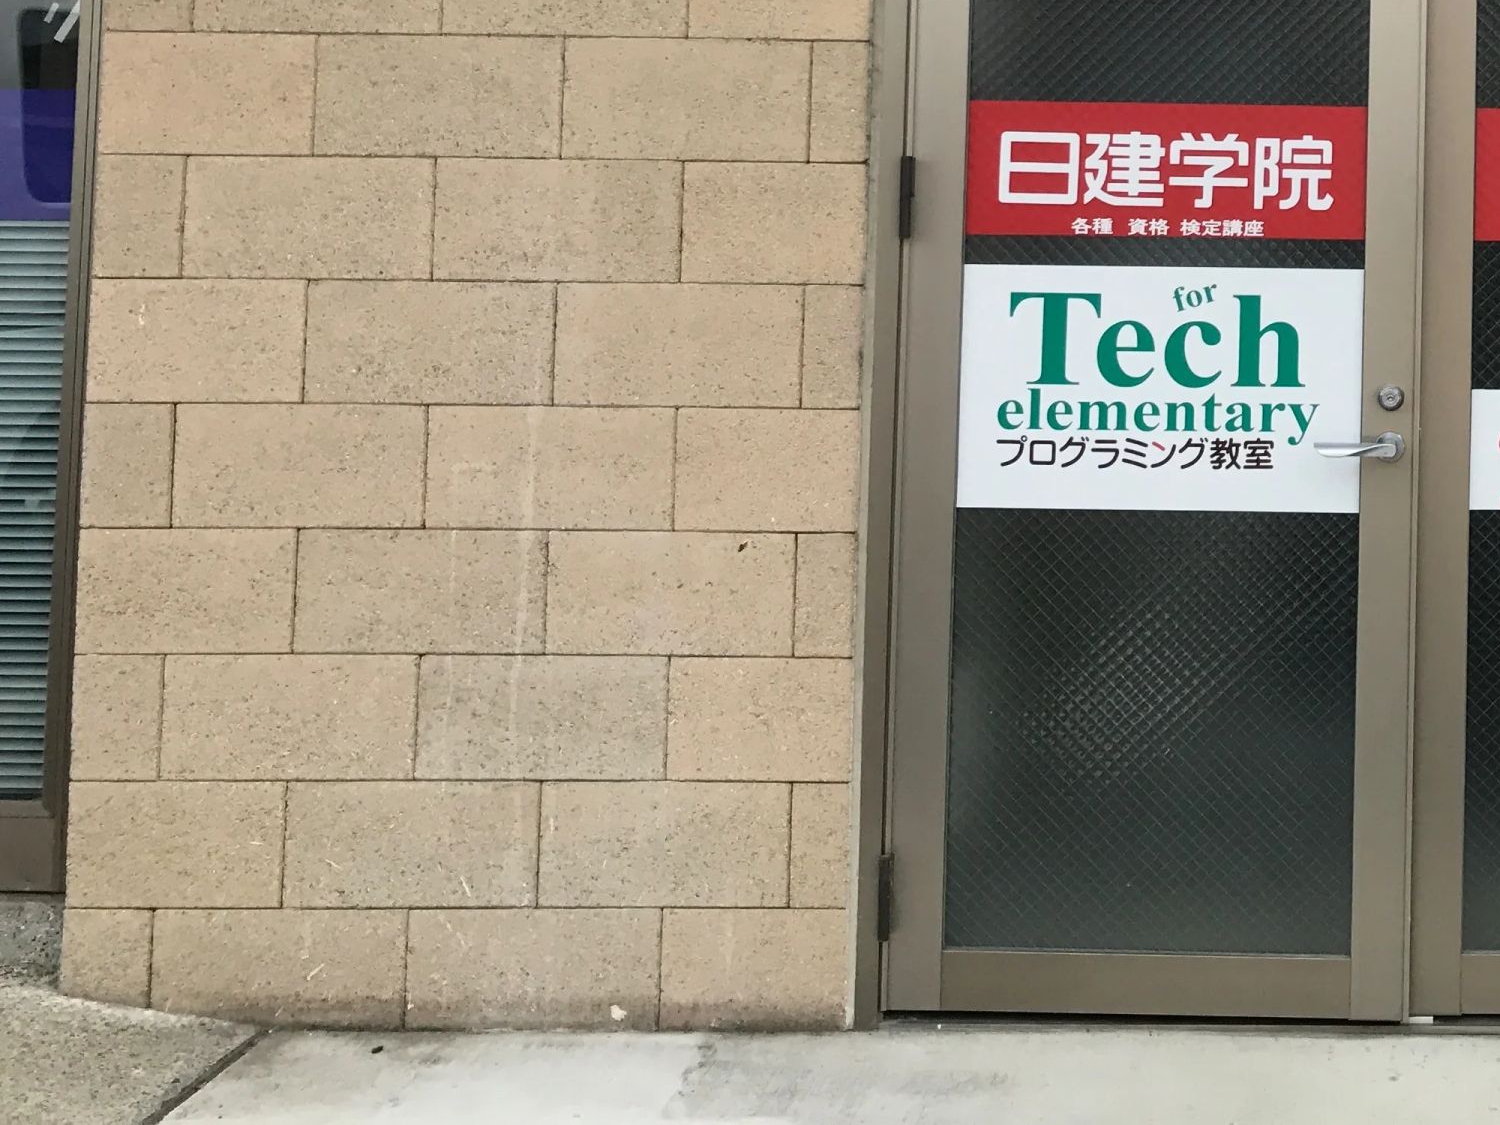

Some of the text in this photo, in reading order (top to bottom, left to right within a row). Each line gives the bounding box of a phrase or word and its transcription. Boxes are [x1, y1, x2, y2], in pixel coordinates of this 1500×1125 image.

[998, 131, 1335, 211] 日建学院
[1071, 217, 1265, 237] 各種 資格 検定講座
[1173, 283, 1218, 312] for
[1009, 291, 1306, 388] Tech
[997, 387, 1320, 446] elementary
[996, 435, 1275, 471] プログラミング教室
